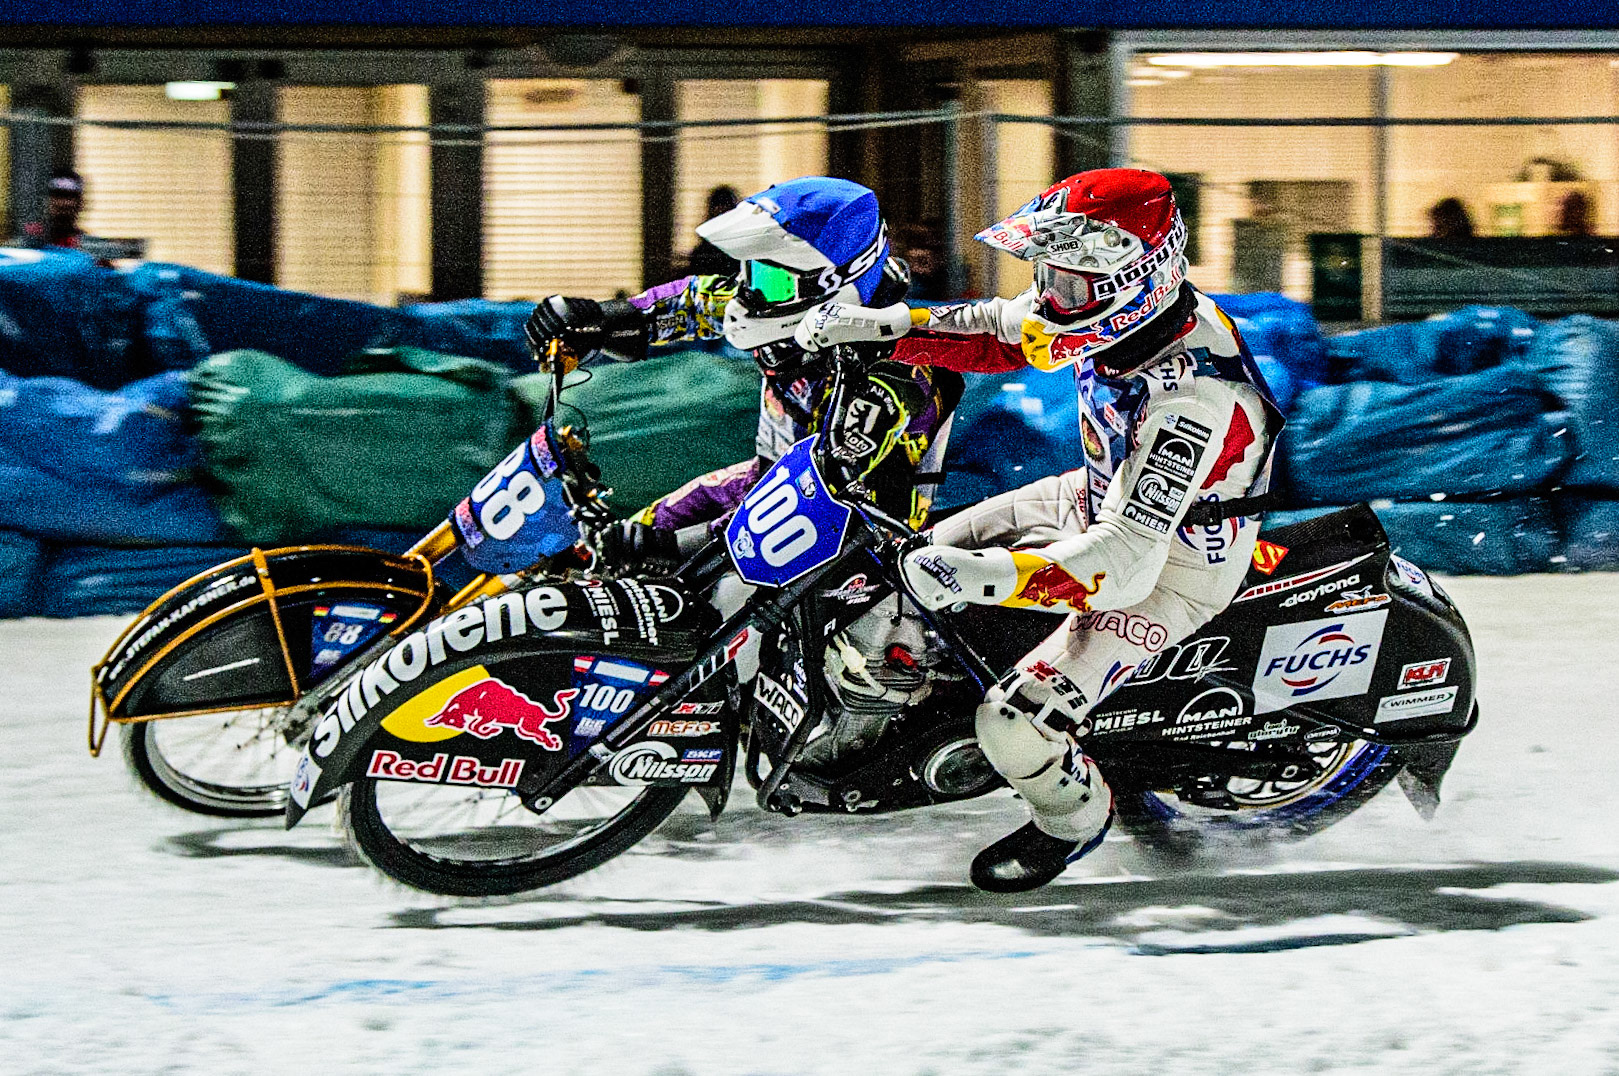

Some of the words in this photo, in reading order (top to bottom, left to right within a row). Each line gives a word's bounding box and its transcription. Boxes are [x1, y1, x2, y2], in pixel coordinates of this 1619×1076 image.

[993, 231, 1024, 251] Bull
[1050, 240, 1079, 252] SHOEI
[1110, 293, 1153, 331] Red
[1151, 264, 1182, 306] Bull
[1159, 354, 1178, 391] CHS
[1149, 453, 1195, 477] HINTSTEINER
[1162, 449, 1192, 466] MAN
[471, 442, 545, 540] 88
[744, 465, 818, 567] 100
[1136, 513, 1168, 534] MIESL
[1280, 574, 1360, 607] daytona
[587, 587, 619, 645] MIESL
[324, 622, 363, 645] 88
[1070, 610, 1168, 652] WACO
[1264, 644, 1371, 676] FUCHS
[579, 683, 635, 713] 100
[758, 677, 799, 728] WACO
[1390, 694, 1445, 707] WIMMER
[1094, 710, 1165, 732] MIESL
[1161, 717, 1253, 737] HINTSTEINER
[1182, 706, 1238, 724] MAN
[368, 750, 448, 782] Red
[447, 756, 526, 788] Bull
[627, 755, 718, 779] Nilsson
